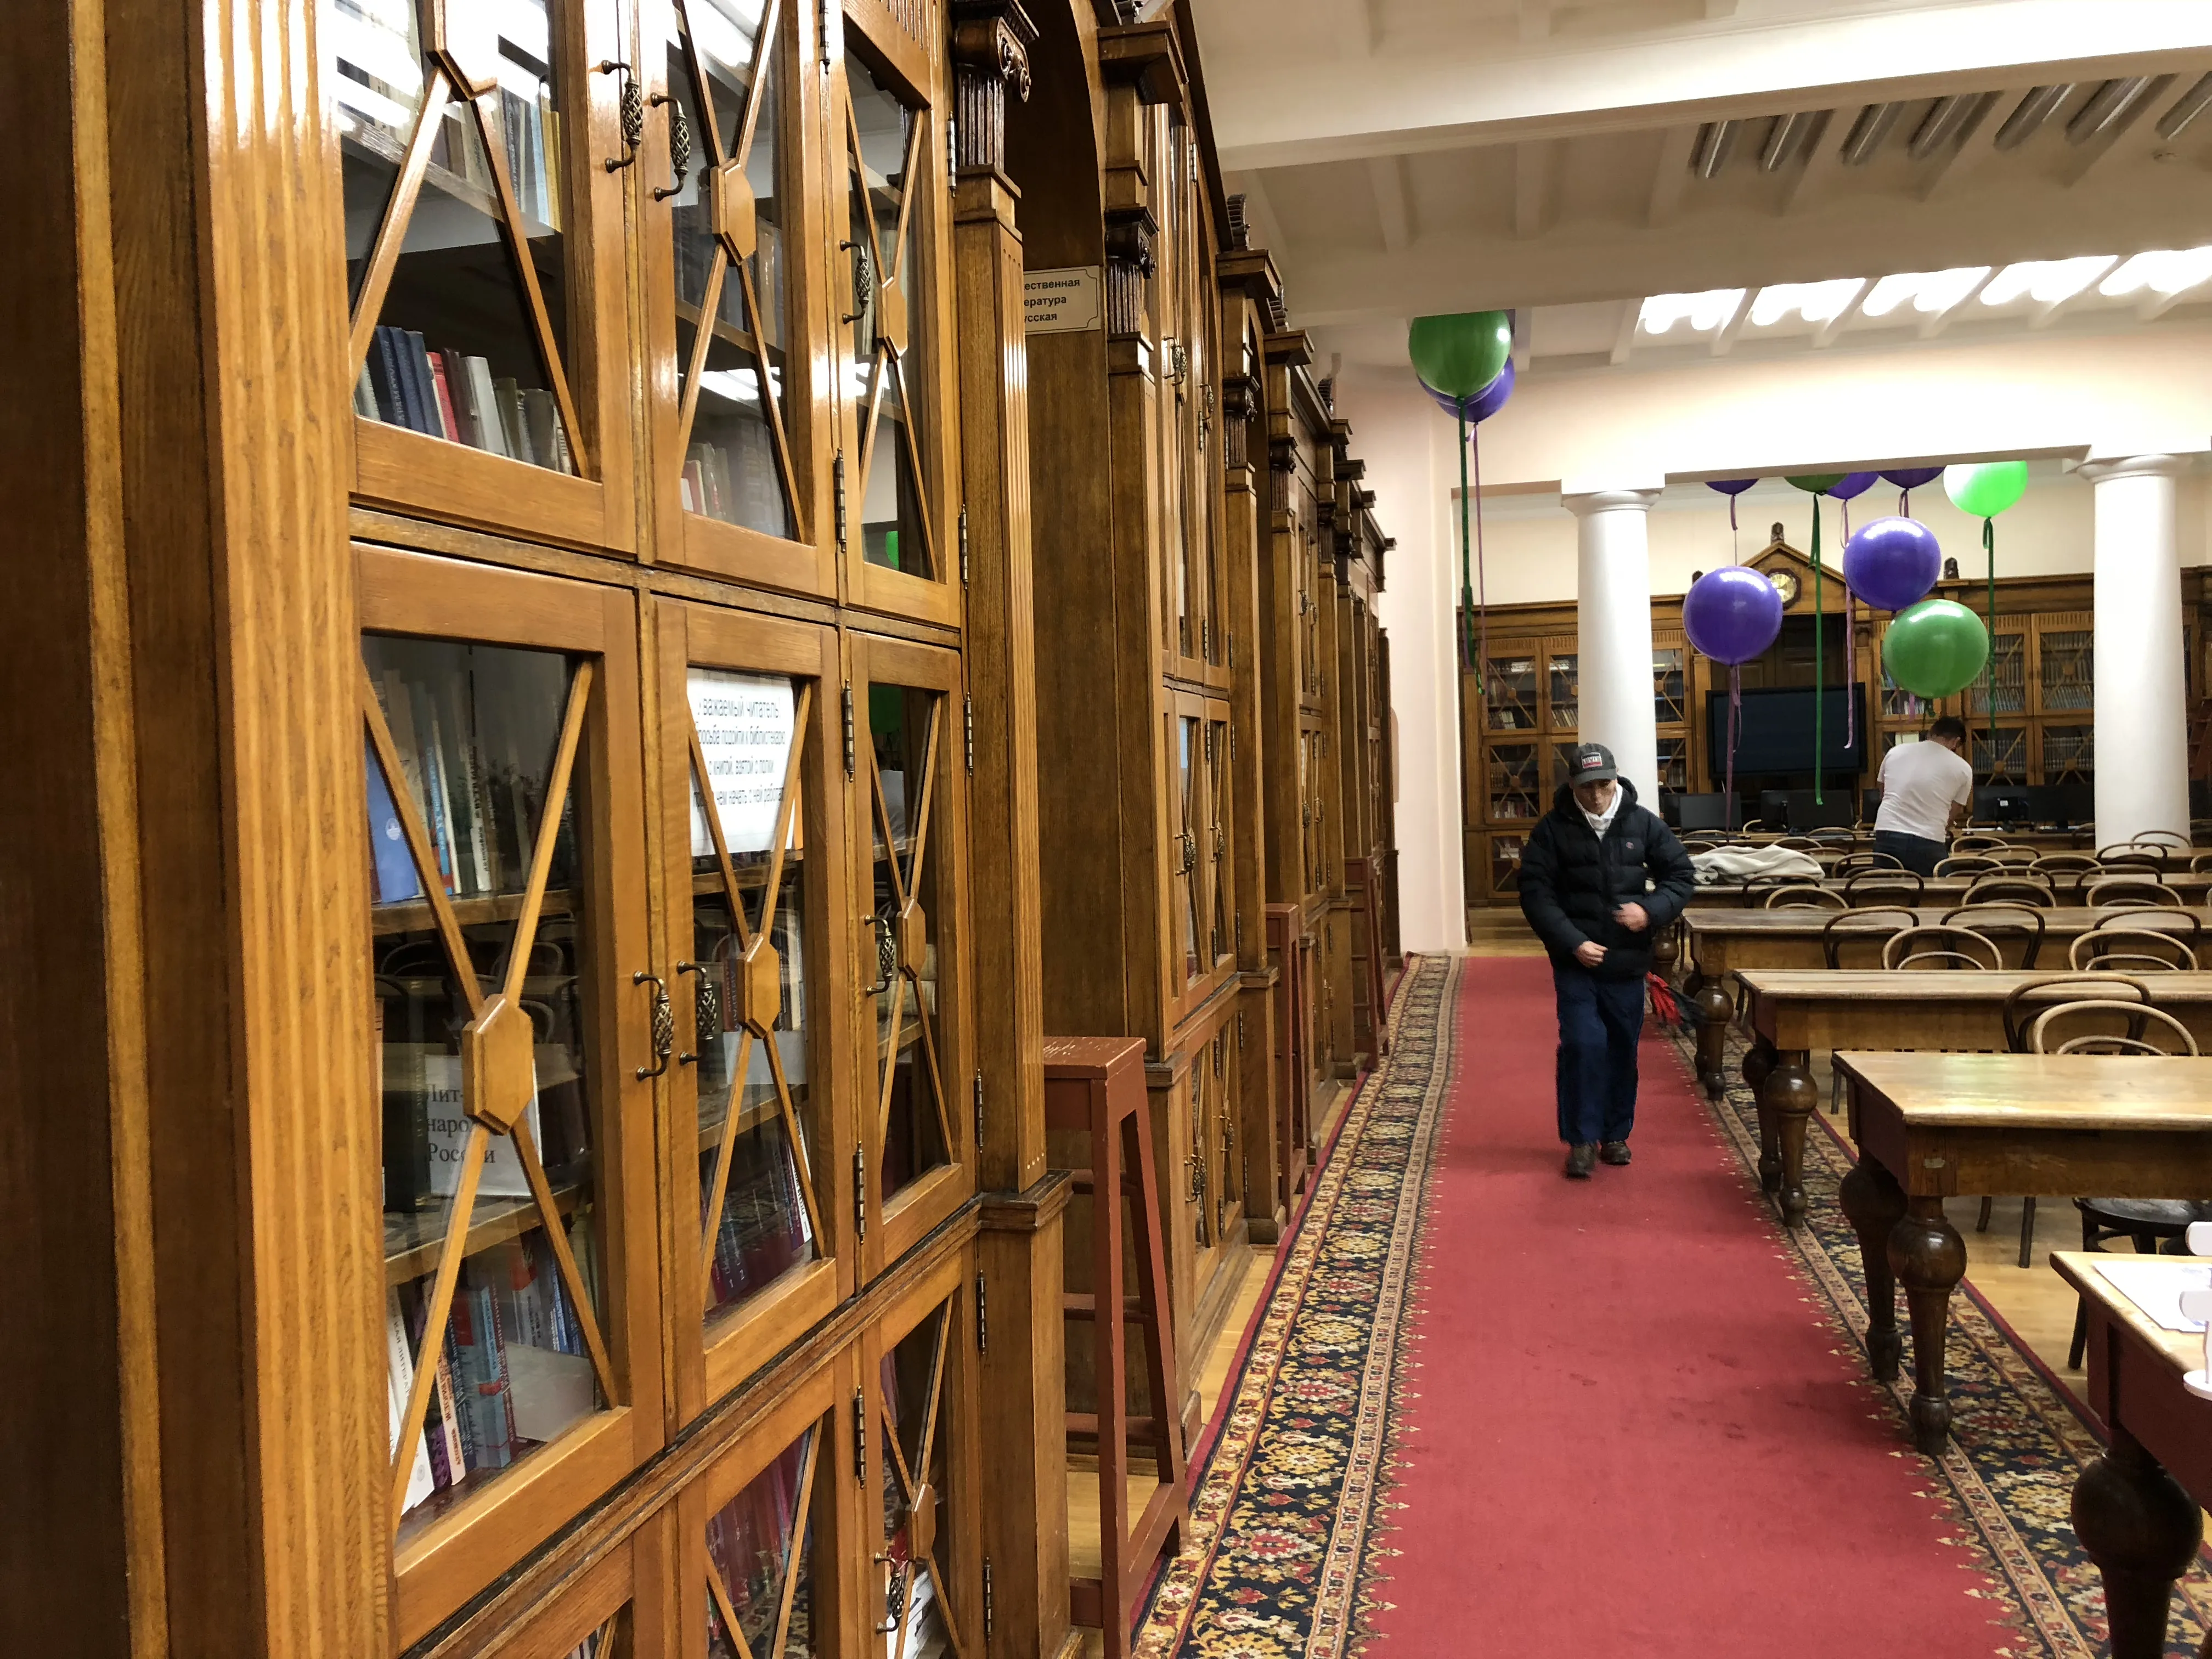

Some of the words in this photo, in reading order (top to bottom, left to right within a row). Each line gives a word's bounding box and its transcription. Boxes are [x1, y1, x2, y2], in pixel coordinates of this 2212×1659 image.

[1024, 279, 1080, 290] ественная
[1024, 296, 1066, 308] ература
[1024, 313, 1057, 323] усская
[696, 721, 720, 745] росьба
[426, 1084, 464, 1102] Лит-
[427, 1118, 470, 1138] наро
[428, 1142, 496, 1163] Роси
